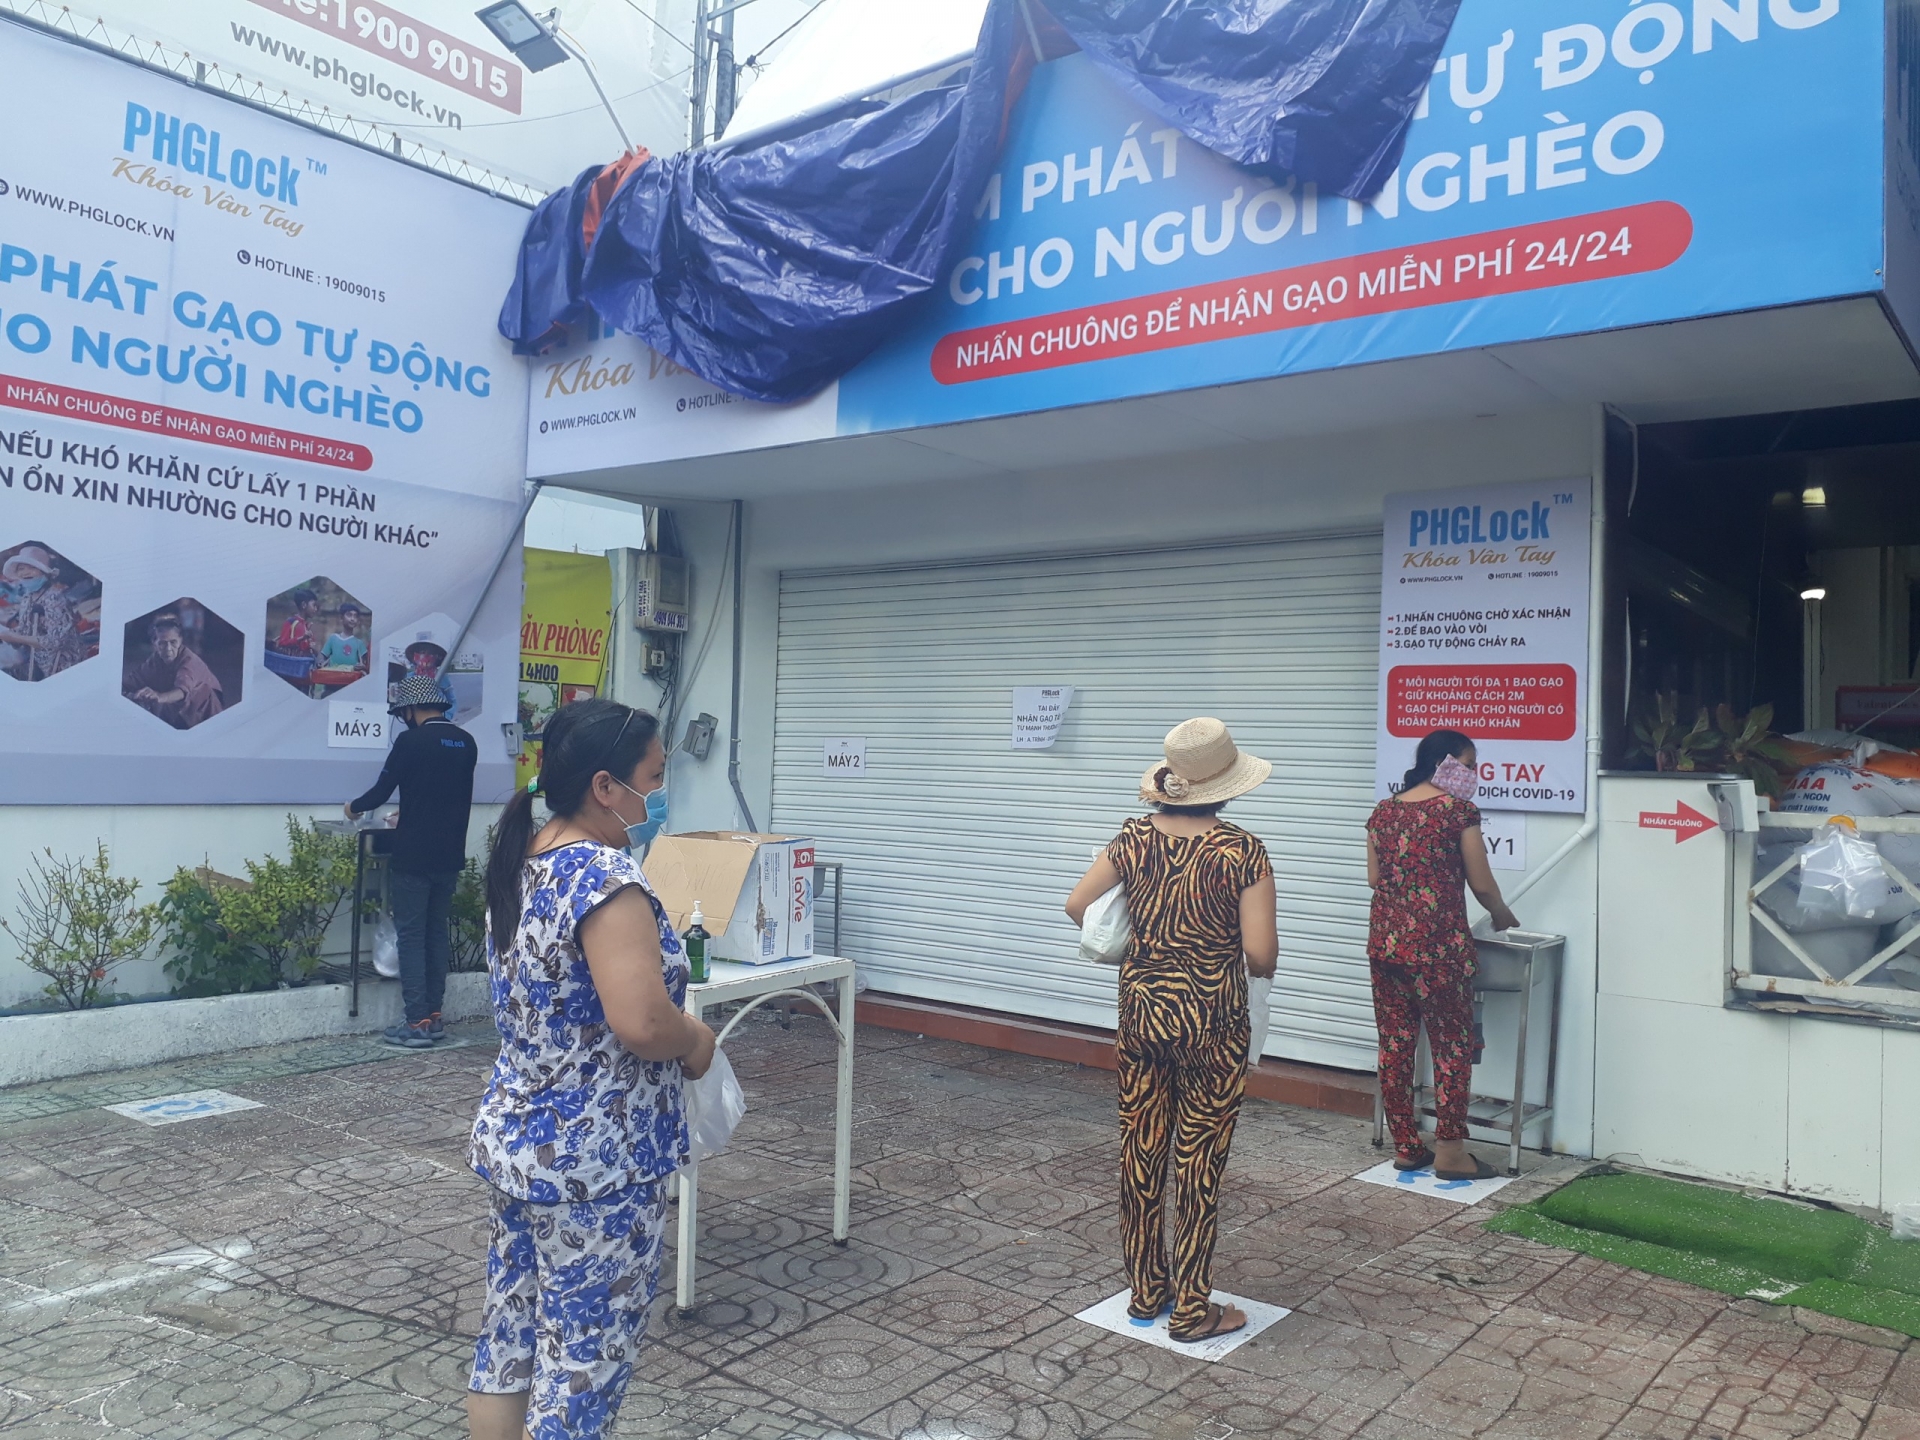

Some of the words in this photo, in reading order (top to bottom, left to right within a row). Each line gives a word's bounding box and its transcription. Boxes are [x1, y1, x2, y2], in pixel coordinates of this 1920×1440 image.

[282, 0, 419, 59] e:1900
[428, 39, 508, 98] 9015
[230, 21, 462, 131] www.phglock.vn
[306, 157, 328, 176] TM
[1022, 121, 1183, 214] PHÁT
[112, 156, 194, 199] Khóa
[203, 185, 252, 218] Vân
[259, 204, 305, 238] Tay
[15, 184, 175, 242] WWW.PHGLOCK.VN
[949, 237, 1074, 307] CHO
[1094, 174, 1318, 278] NGƯỜI
[1347, 110, 1664, 227] NGHÈO
[255, 254, 314, 283] HOTLINE
[324, 273, 387, 303] 19009015
[956, 328, 1023, 369] NHẤN
[1029, 315, 1137, 355] CHUÔNG
[1146, 298, 1182, 335] ĐỂ
[1189, 288, 1272, 330] NHẬN
[1283, 275, 1348, 313] GẠO
[1358, 254, 1442, 298] MIỄN
[1454, 239, 1515, 283] PHÍ
[1524, 226, 1632, 274] 24/24
[1, 243, 158, 315] PHÁT
[173, 291, 282, 347] GẠO
[296, 320, 359, 373] TỰ
[367, 340, 490, 398] ĐỘNG
[71, 325, 246, 398] NGƯỜI
[264, 369, 423, 433] NGHÈO
[544, 354, 635, 399] Khóa
[689, 391, 732, 410] HOTLINE
[7, 383, 59, 408] NHẤN
[64, 393, 136, 422] CHUÔNG
[141, 408, 162, 427] ĐỂ
[166, 415, 211, 437] NHẬN
[215, 424, 246, 444] GẠO
[250, 428, 287, 449] MIỄN
[290, 437, 313, 455] PHÍ
[317, 443, 354, 463] 24/24
[551, 407, 637, 431] WWW.PHGLOCK.VN
[0, 429, 53, 459] NẾU
[62, 441, 119, 470] KHÓ
[128, 453, 199, 484] KHĂN
[207, 466, 244, 490] CỨ
[248, 471, 291, 498] LẤY
[297, 482, 307, 501] 1
[316, 484, 376, 513] PHẦN
[23, 463, 64, 495] ỔN
[72, 476, 119, 503] XIN
[127, 485, 237, 521] NHƯỜNG
[244, 504, 292, 529] CHO
[299, 511, 368, 541] NGƯỜI
[1553, 493, 1573, 505] TM
[1402, 551, 1460, 568] Khóa
[1468, 549, 1508, 565] Vân
[1515, 545, 1556, 566] Tay
[1407, 575, 1463, 583] WWW.PHGLOCK.VN
[1495, 571, 1523, 579] HOTLINE
[1527, 570, 1558, 578] 19009015
[1396, 610, 1434, 623] 1.NHẤN
[1437, 609, 1482, 622] CHUÔNG
[1486, 608, 1510, 620] CHỜ
[1512, 607, 1535, 619] XÁC
[1538, 606, 1571, 620] NHẬN
[543, 618, 603, 657] PHÒNG
[1395, 624, 1417, 636] 2.ĐỂ
[1420, 625, 1441, 635] BAO
[1444, 623, 1466, 634] VÀO
[1468, 622, 1487, 634] VÒI
[1394, 639, 1425, 650] 3.GẠO
[1428, 638, 1444, 650] TỰ
[1445, 636, 1475, 650] ĐỘNG
[1478, 635, 1508, 647] CHẢY
[1511, 636, 1526, 646] RA
[519, 662, 559, 682] 14H00
[1429, 675, 1463, 687] NGƯỜI
[1465, 675, 1483, 687] TỐI
[1485, 677, 1501, 687] ĐA
[1504, 678, 1509, 687] 1
[1513, 678, 1536, 687] BAO
[1539, 677, 1564, 689] GẠO
[1405, 689, 1425, 700] GIỮ
[1426, 689, 1471, 701] KHOẢNG
[1474, 689, 1505, 700] CÁCH
[1508, 691, 1524, 700] 2M
[1017, 714, 1038, 723] NHẬN
[1040, 715, 1053, 723] GẠO
[1405, 704, 1427, 716] GẠO
[1429, 701, 1448, 714] CHỈ
[1451, 702, 1480, 714] PHÁT
[1482, 704, 1506, 714] CHO
[1508, 702, 1545, 715] NGƯỜI
[1548, 702, 1564, 715] CÓ
[335, 718, 370, 737] MÁY
[372, 724, 382, 738] 3
[1463, 715, 1486, 727] KHÓ
[1488, 716, 1520, 728] KHĂN
[828, 751, 852, 767] MÁY
[853, 755, 860, 767] 2
[1501, 763, 1545, 783] TAY
[1478, 786, 1509, 800] DỊCH
[1513, 787, 1575, 801] COVID-19
[1803, 792, 1831, 802] NGON
[1643, 815, 1668, 826] NHẤN
[1668, 817, 1703, 828] CHUÔNG
[800, 851, 810, 864] 6
[794, 875, 806, 923] laVie
